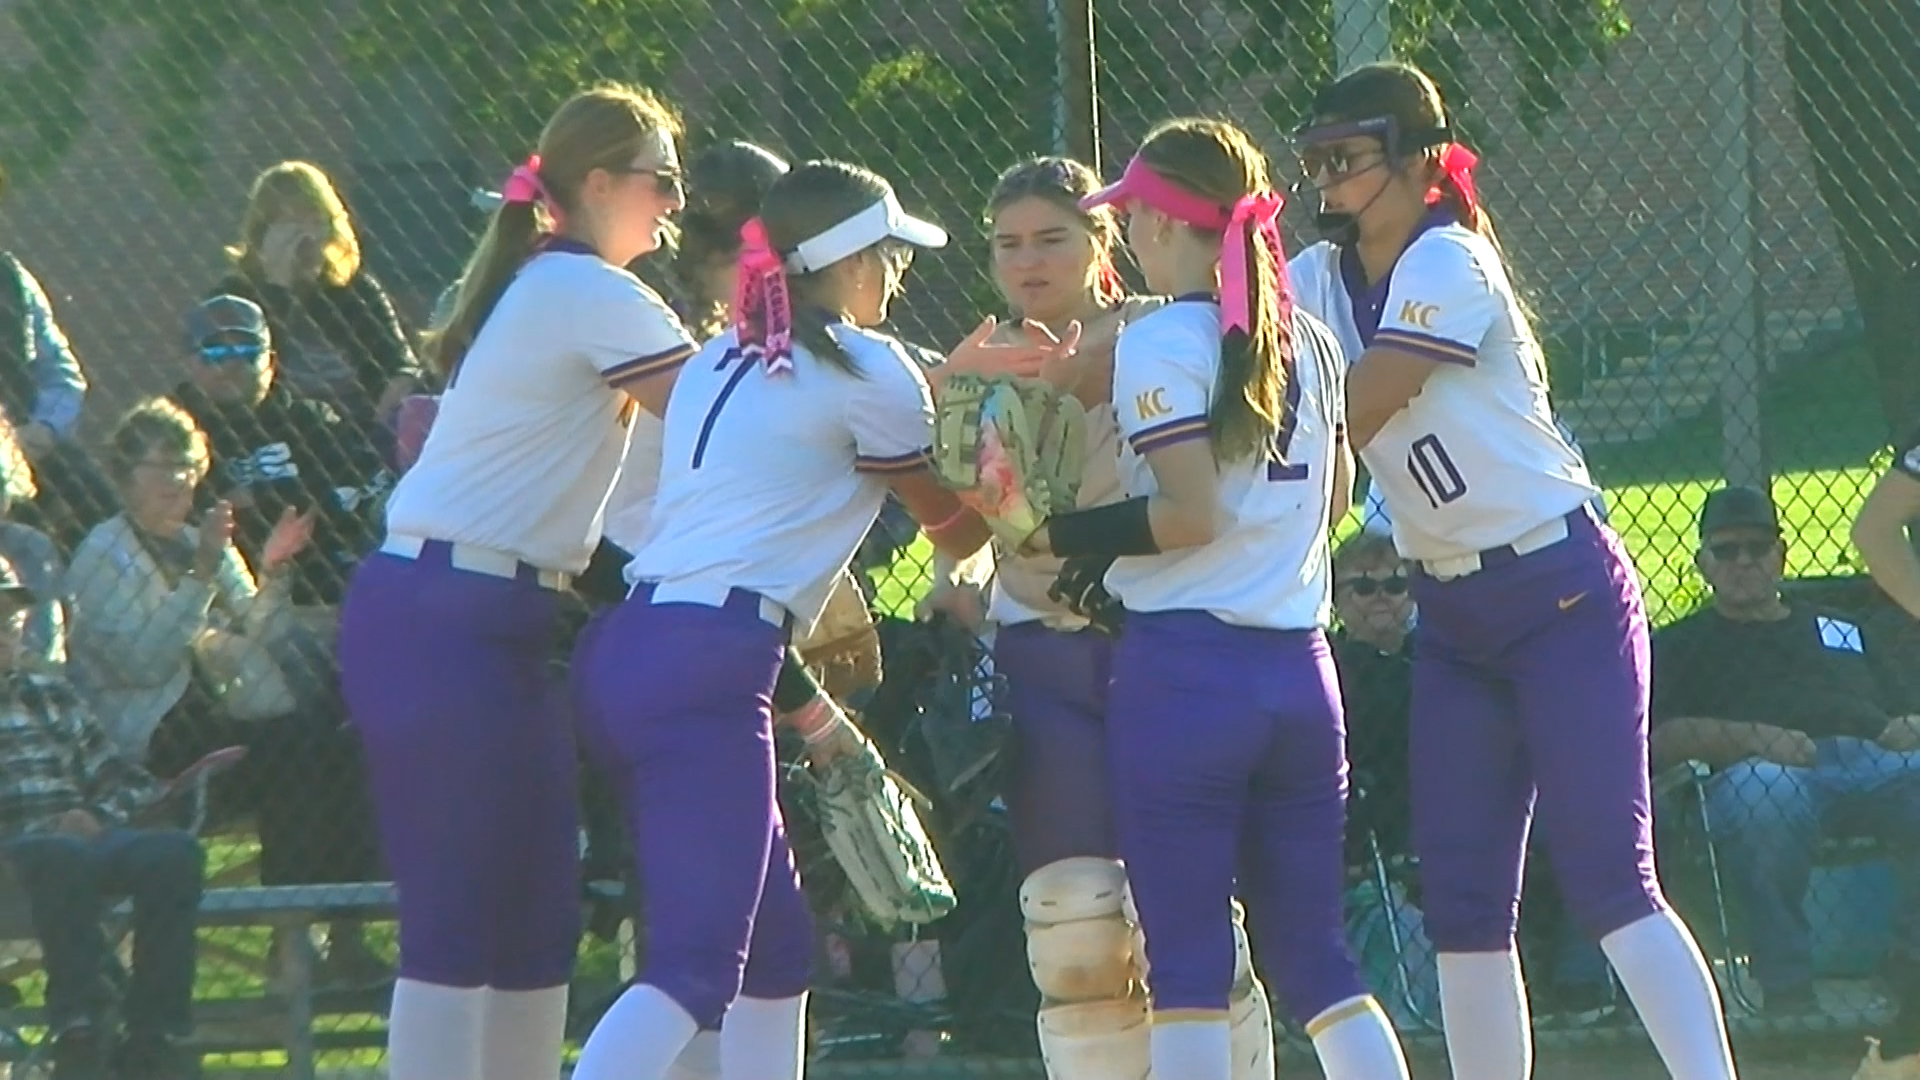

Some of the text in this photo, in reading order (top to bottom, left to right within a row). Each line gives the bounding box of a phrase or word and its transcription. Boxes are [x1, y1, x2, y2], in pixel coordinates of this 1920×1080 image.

[1399, 299, 1440, 329] KC
[692, 348, 762, 469] 7
[1136, 387, 1173, 419] KC
[1407, 433, 1467, 509] 10
